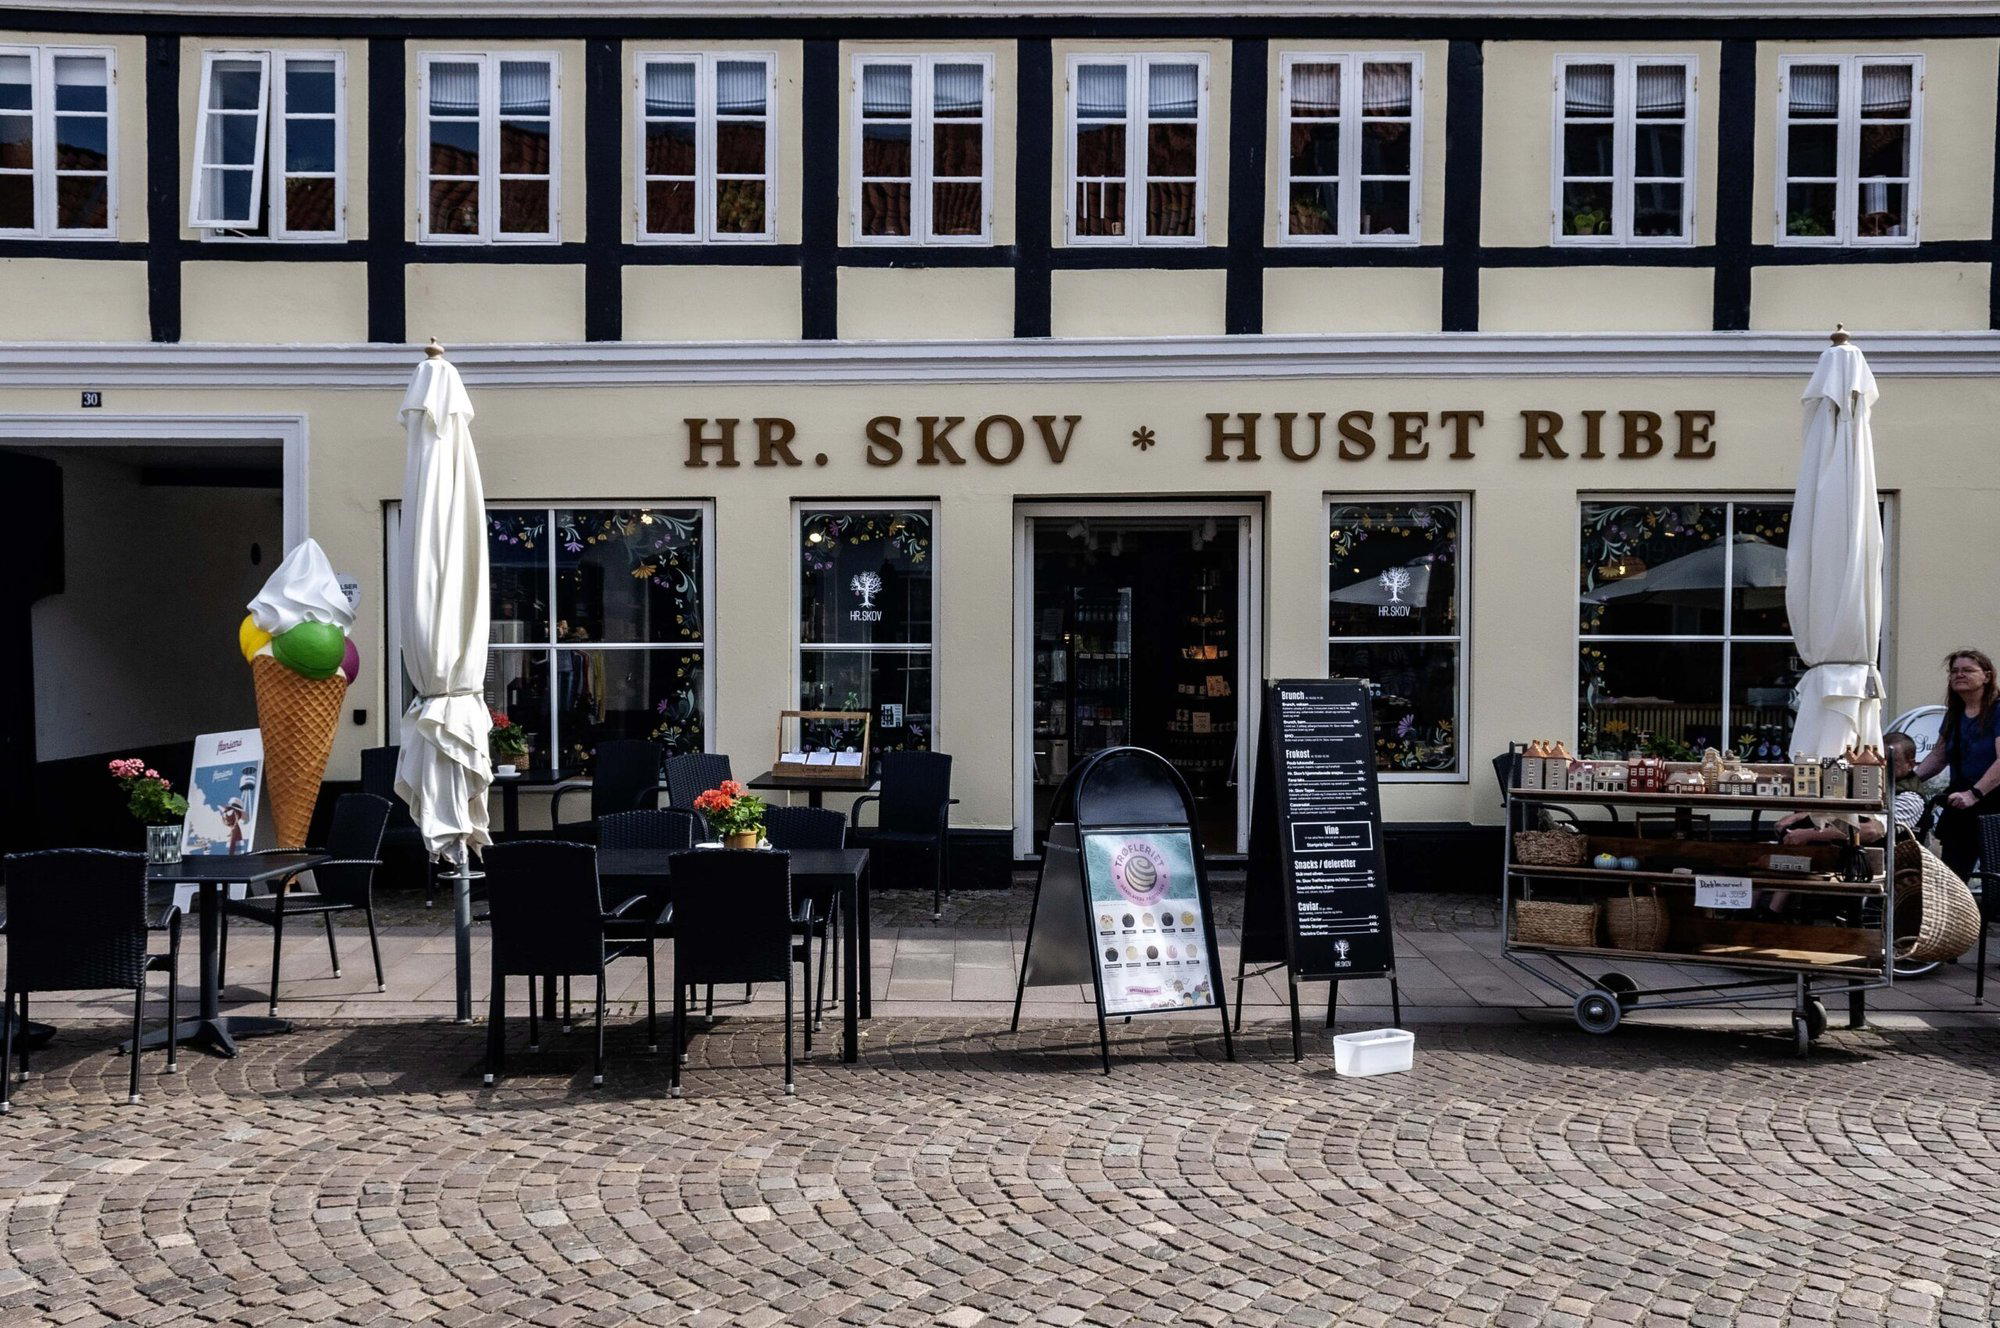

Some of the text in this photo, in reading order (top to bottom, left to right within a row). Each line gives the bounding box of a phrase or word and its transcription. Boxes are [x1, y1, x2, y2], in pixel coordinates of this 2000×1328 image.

[84, 393, 98, 405] 30
[683, 409, 1718, 467] HR. SKOV HUSET RIBE
[850, 610, 882, 621] HR.SKOV
[1281, 691, 1305, 700] Brunch
[1285, 749, 1310, 759] Frokost
[1324, 825, 1340, 835] Vine
[1294, 860, 1319, 870] Snacks
[1323, 858, 1356, 869] deleretter
[1297, 902, 1319, 911] Caviar
